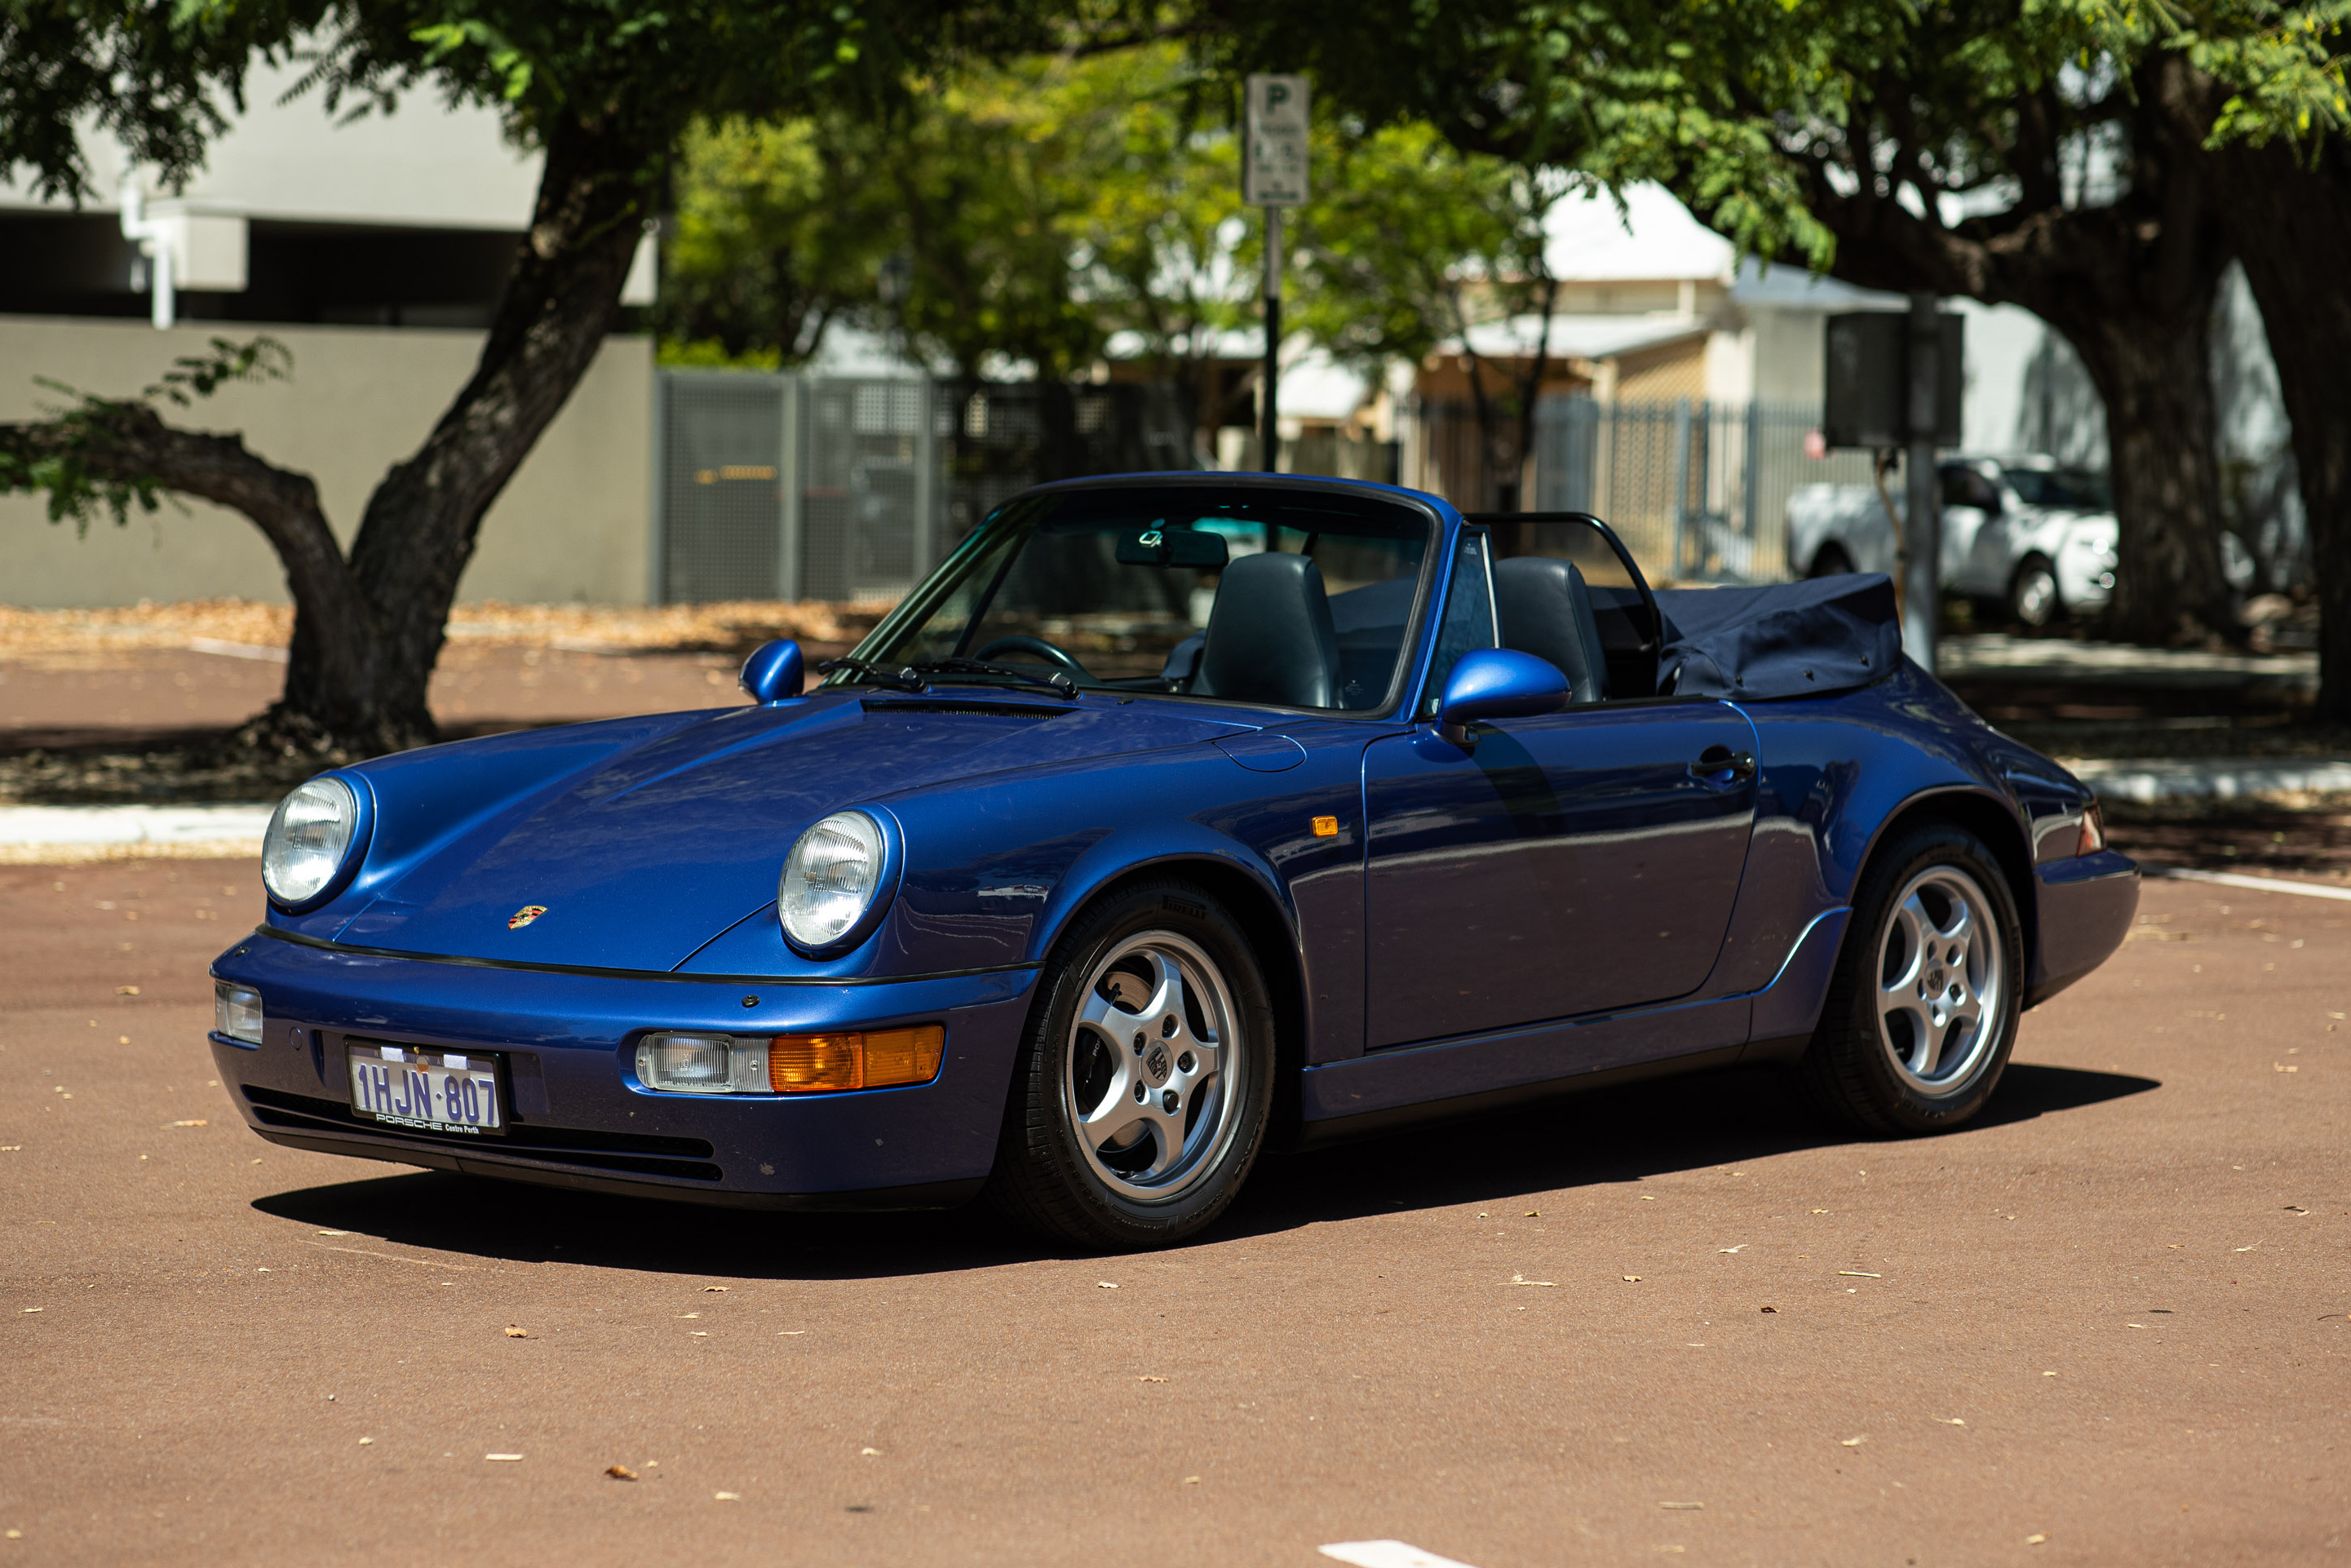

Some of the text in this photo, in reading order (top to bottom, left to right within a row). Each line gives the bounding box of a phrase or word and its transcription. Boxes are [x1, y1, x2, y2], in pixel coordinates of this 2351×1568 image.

[1266, 84, 1291, 114] P
[376, 1114, 480, 1134] PORSCHE Centre Perth
